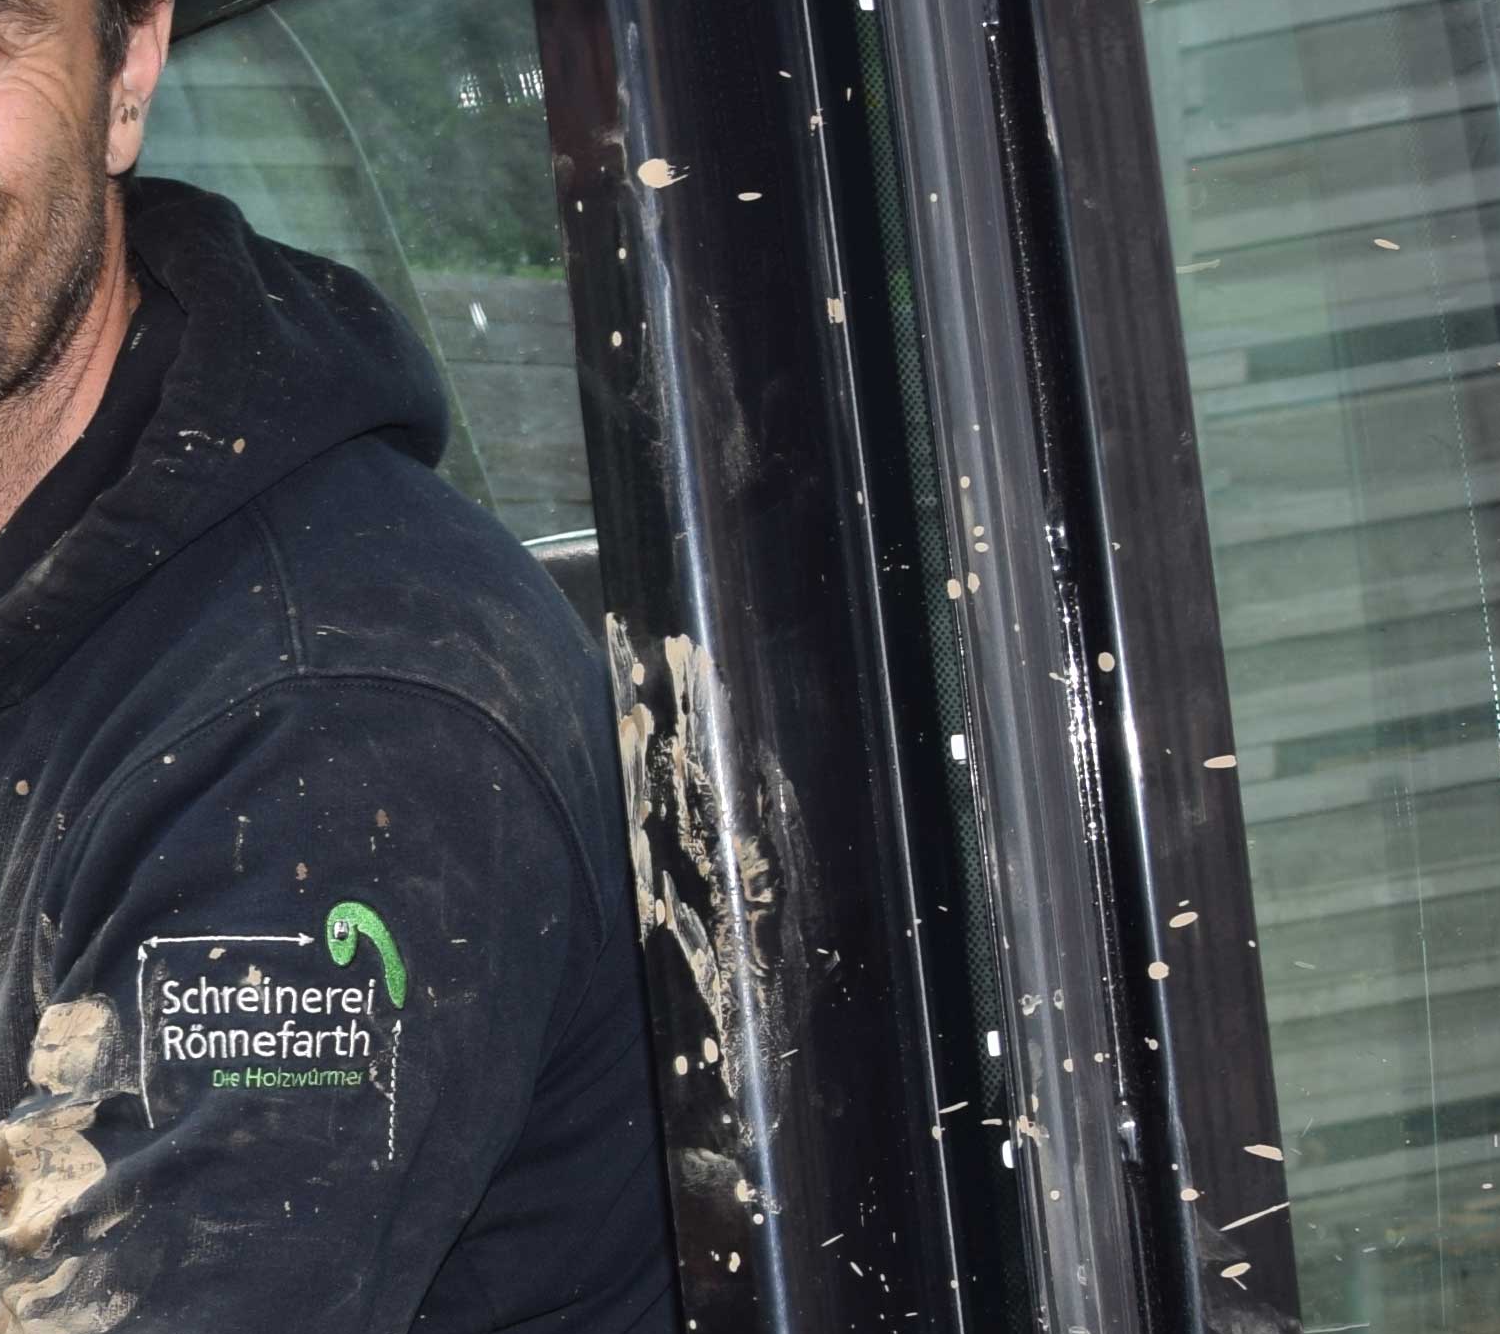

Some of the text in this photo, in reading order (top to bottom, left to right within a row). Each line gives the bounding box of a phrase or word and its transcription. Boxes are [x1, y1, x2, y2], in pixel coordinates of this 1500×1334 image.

[162, 977, 376, 1015] Schreinerei
[163, 1019, 369, 1060] Rönnefarth
[213, 1070, 240, 1087] Die
